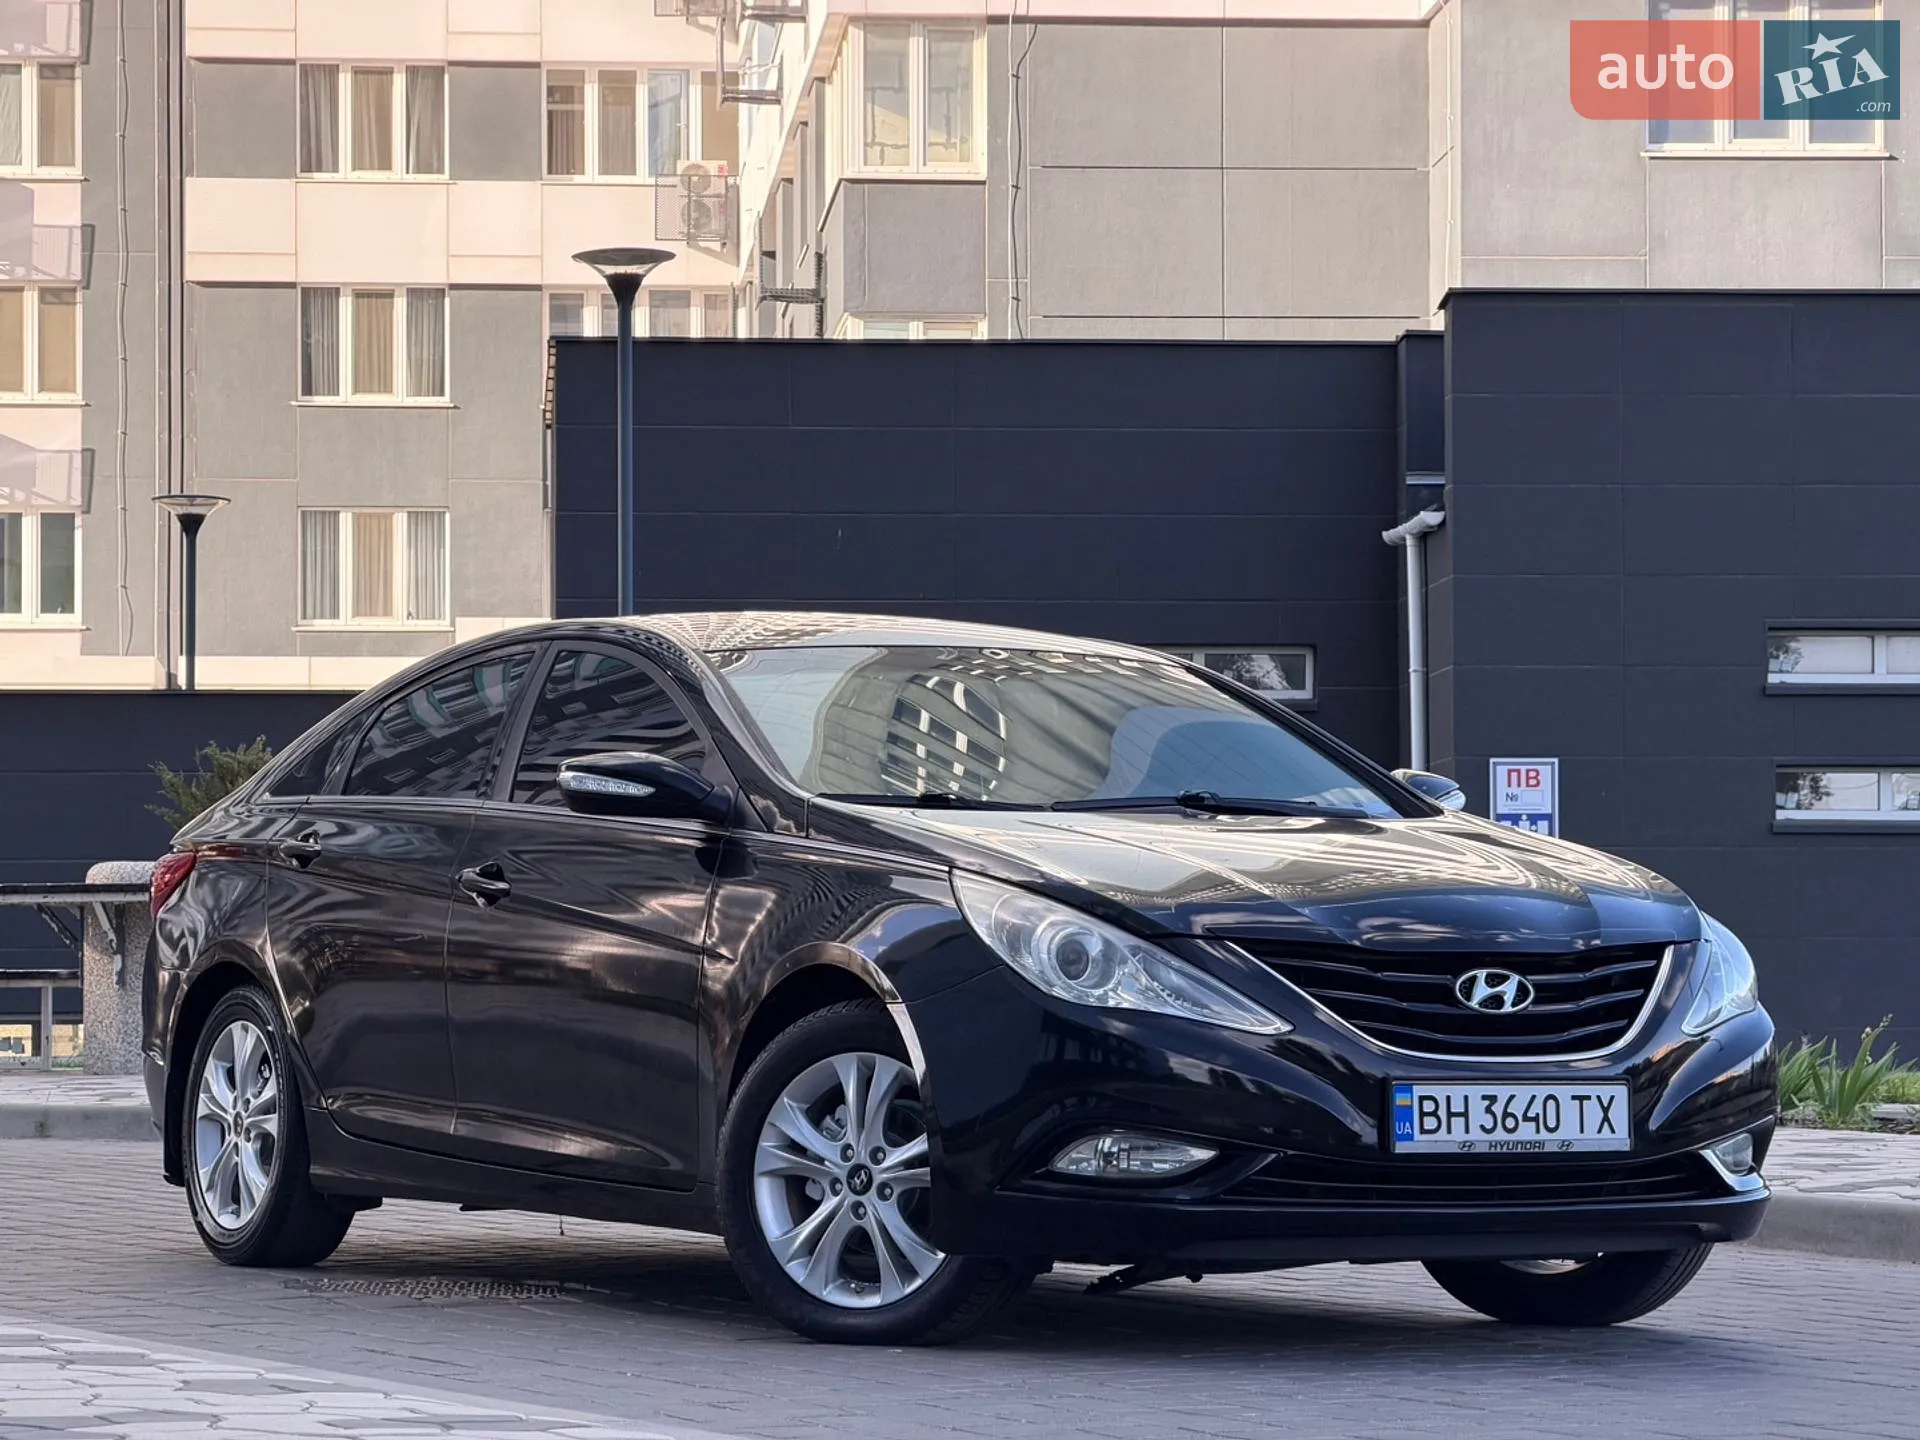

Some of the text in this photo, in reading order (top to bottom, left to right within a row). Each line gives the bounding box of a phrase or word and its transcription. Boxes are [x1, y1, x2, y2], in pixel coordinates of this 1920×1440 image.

[1507, 768, 1541, 788] ПВ
[1417, 1094, 1616, 1135] BH 3640 TX
[1395, 1121, 1413, 1135] UA
[1488, 1140, 1546, 1151] HYUNDAI
